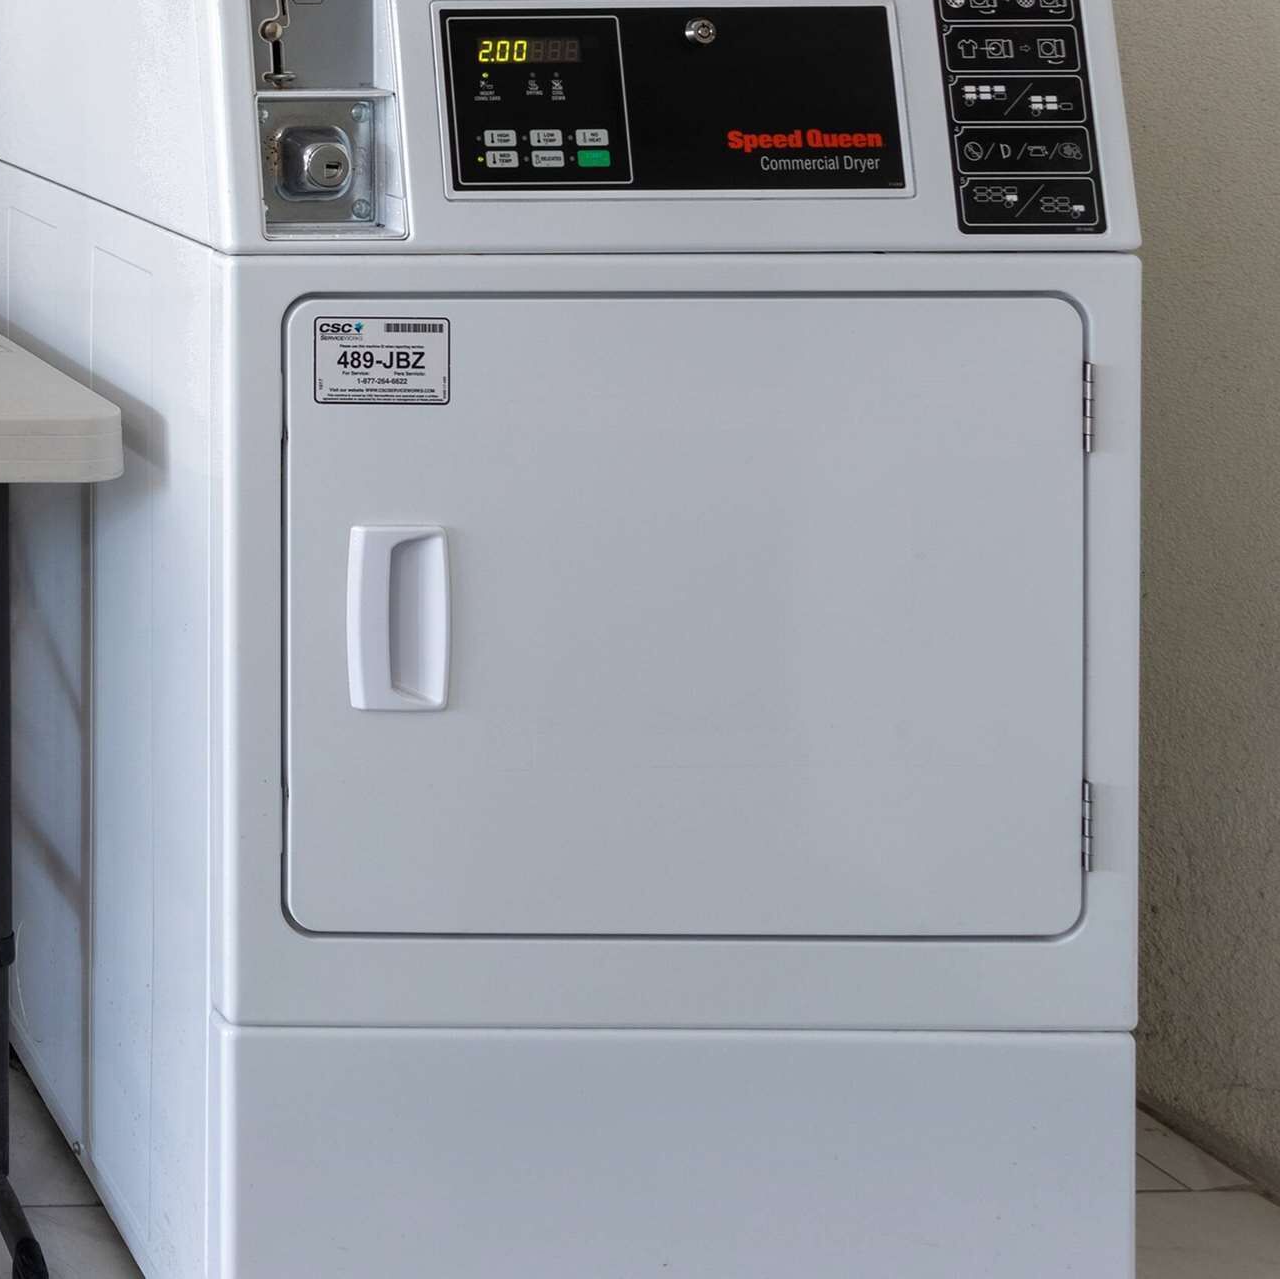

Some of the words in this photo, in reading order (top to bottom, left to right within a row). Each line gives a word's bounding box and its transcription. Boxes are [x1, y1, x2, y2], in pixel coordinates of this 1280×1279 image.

[478, 40, 527, 62] 2.00
[727, 129, 802, 153] Speed
[806, 129, 883, 148] Queen
[760, 155, 839, 171] Commercial
[843, 156, 880, 173] Dryer
[319, 323, 352, 333] CSC
[337, 351, 425, 369] 489-JBZ
